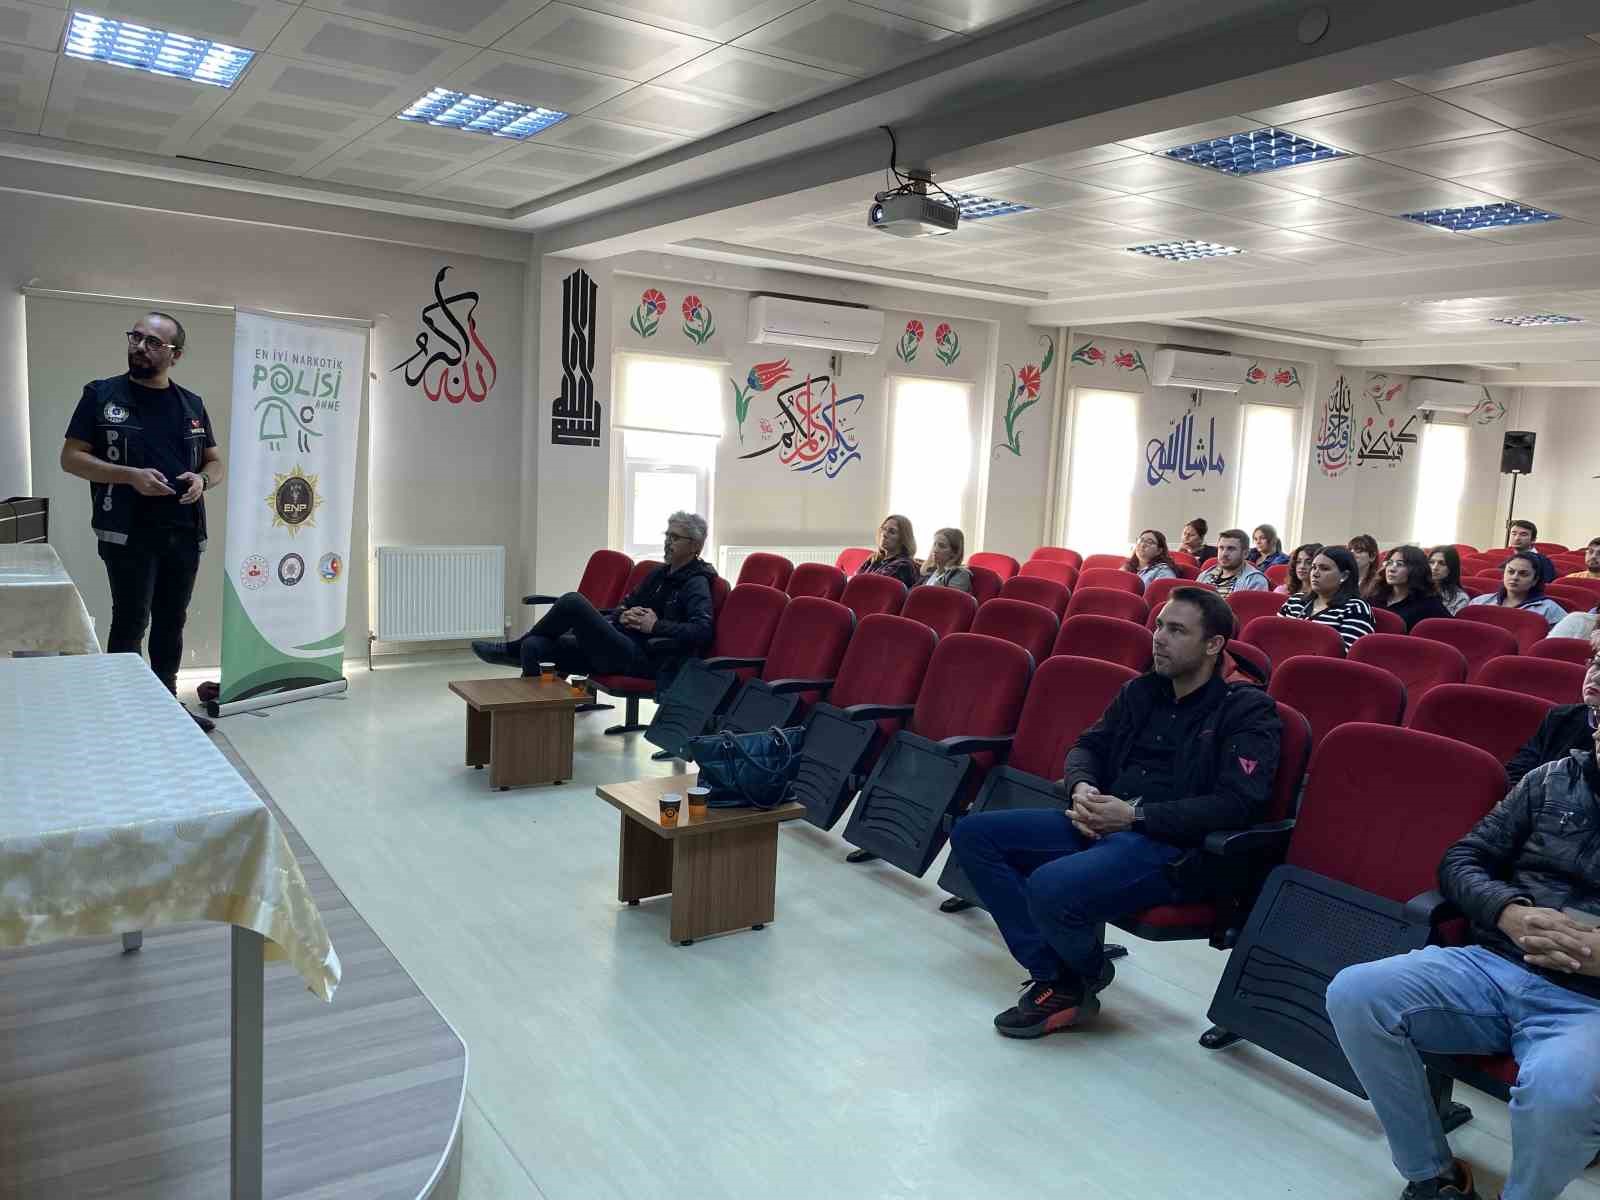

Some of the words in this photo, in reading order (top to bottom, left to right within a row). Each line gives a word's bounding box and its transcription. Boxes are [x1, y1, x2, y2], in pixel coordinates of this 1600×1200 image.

[255, 348, 269, 359] EN
[292, 352, 344, 369] NARKOTİK
[252, 363, 342, 399] POLİSİ
[283, 503, 308, 512] ENP
